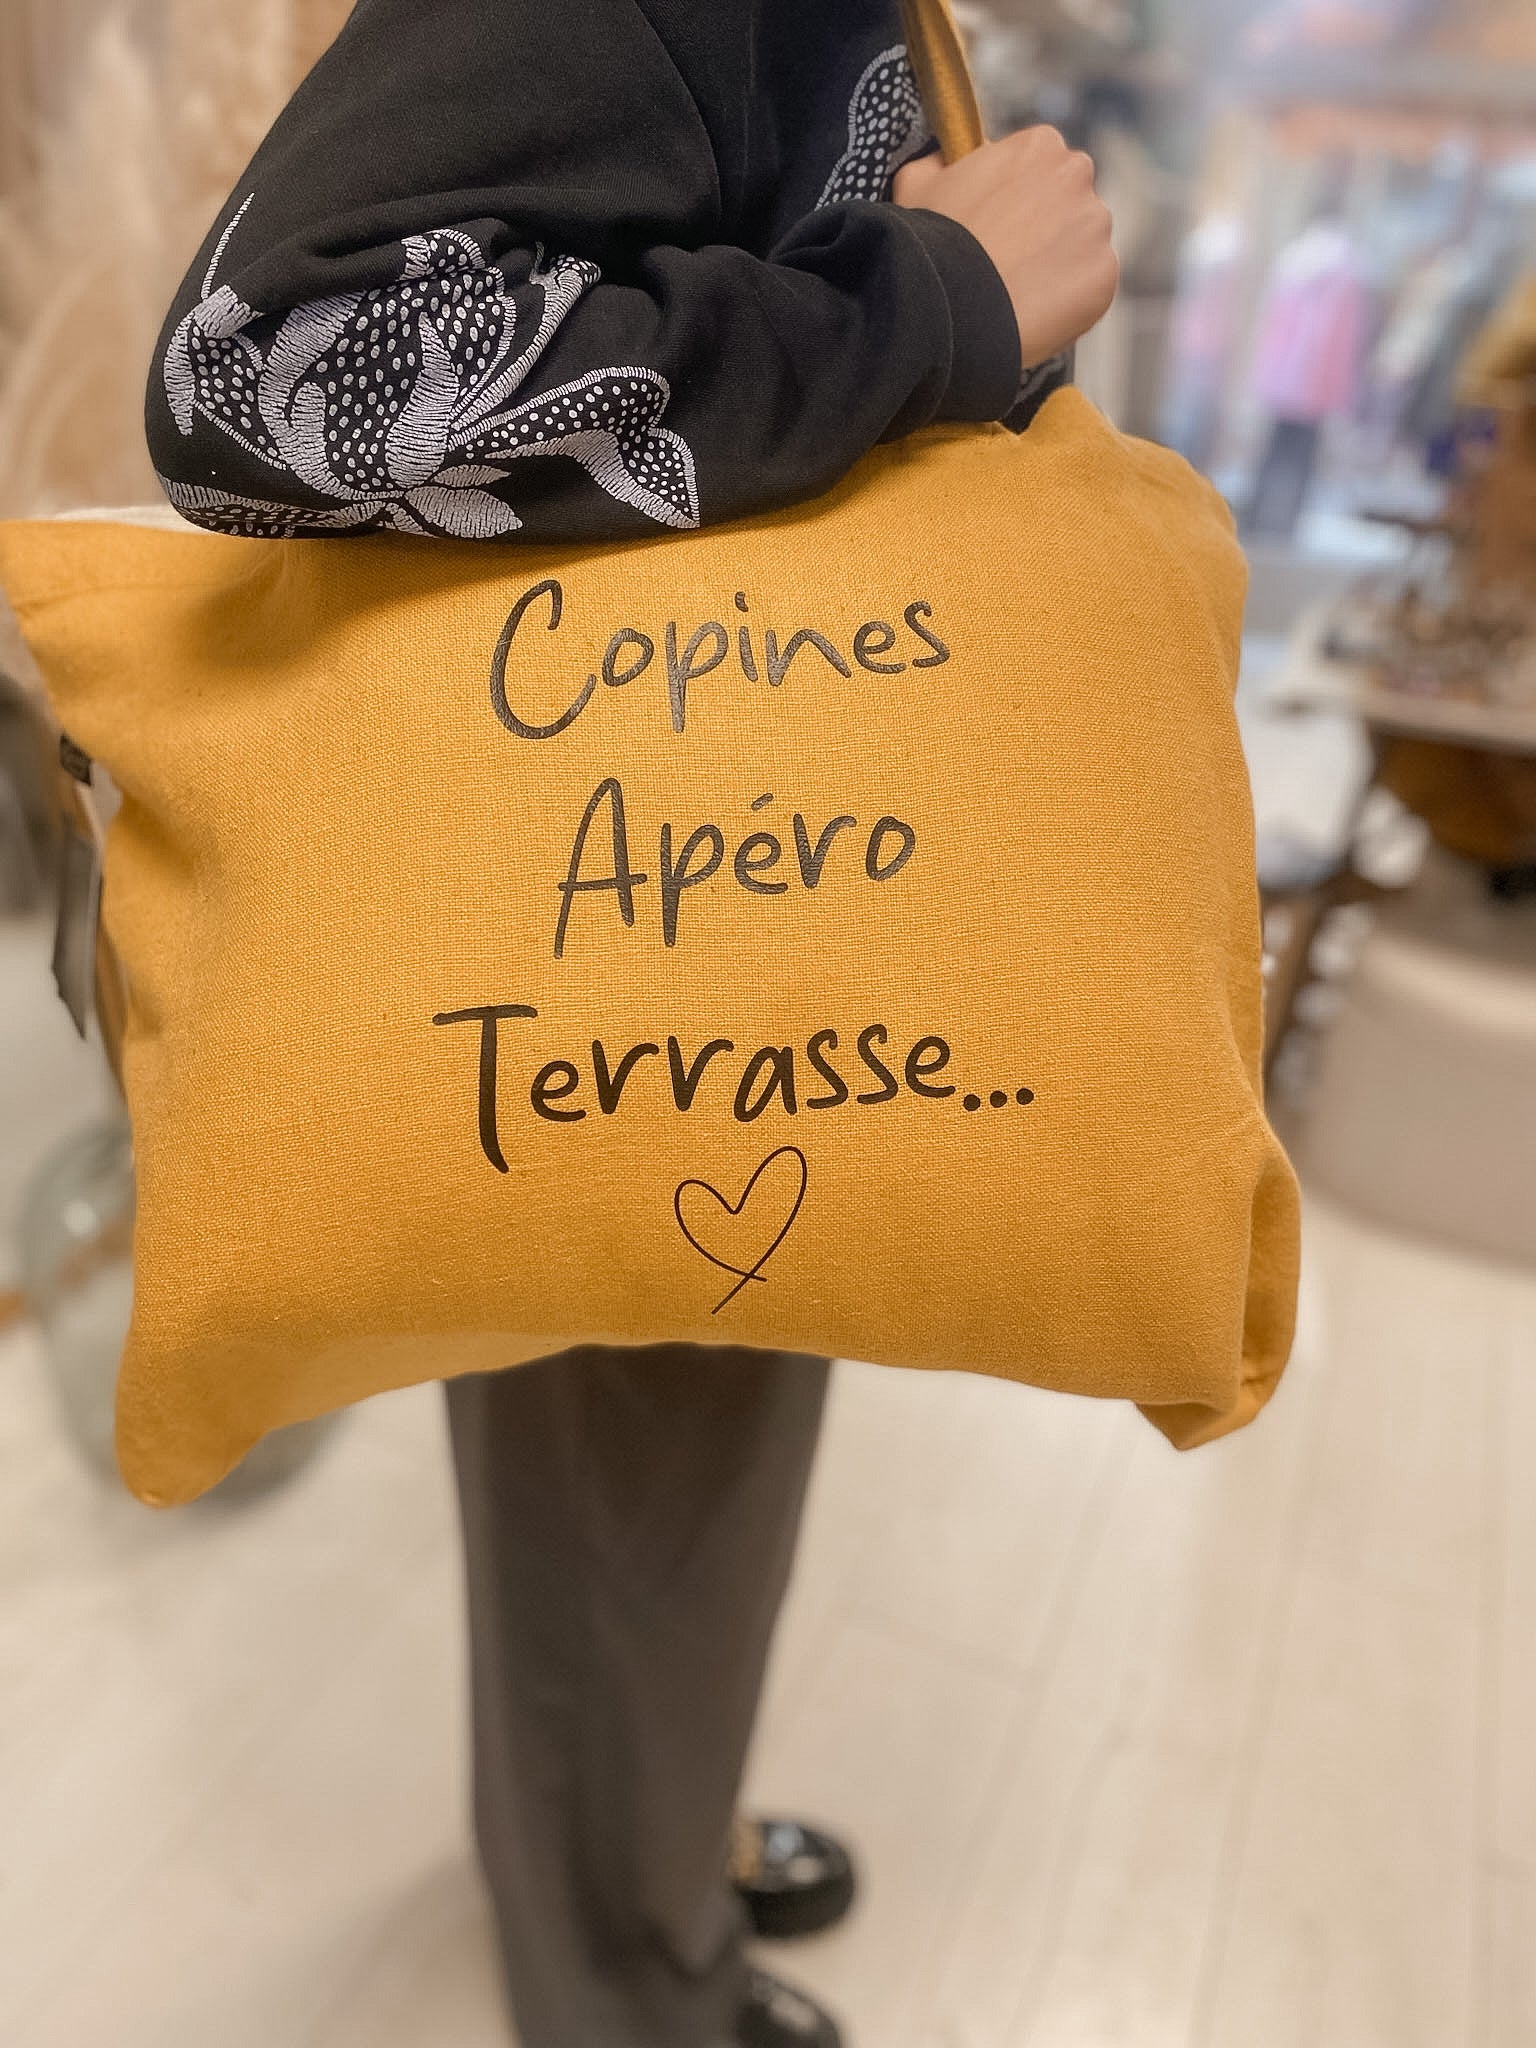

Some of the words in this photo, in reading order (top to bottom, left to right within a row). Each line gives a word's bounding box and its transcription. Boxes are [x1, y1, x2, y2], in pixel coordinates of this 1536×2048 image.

[489, 579, 951, 739] Copines
[553, 777, 916, 960] Apéro
[432, 1003, 1035, 1174] Terrasse...
